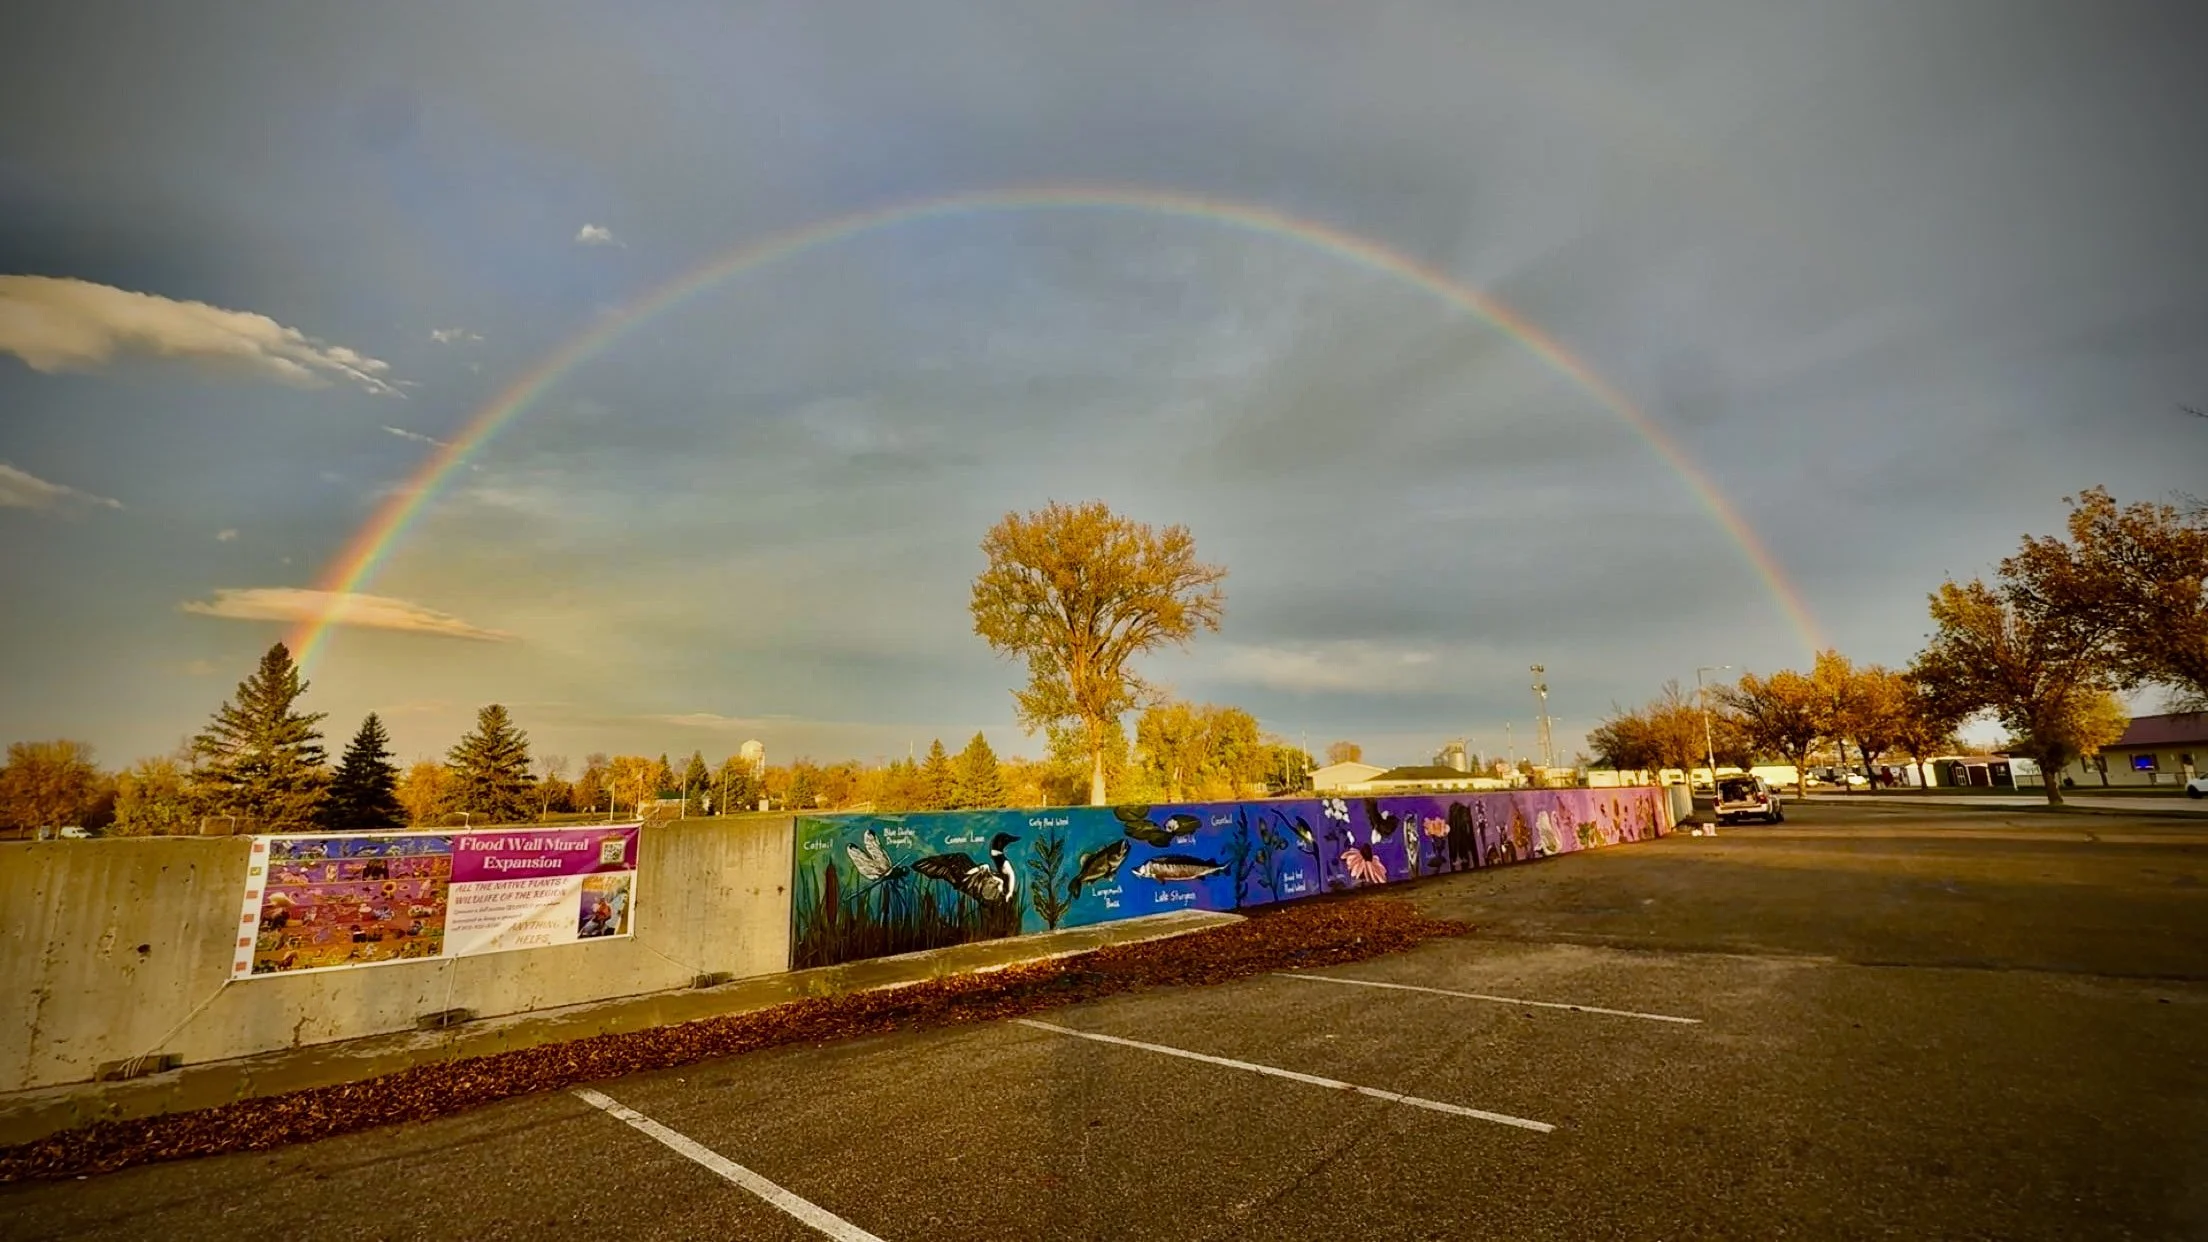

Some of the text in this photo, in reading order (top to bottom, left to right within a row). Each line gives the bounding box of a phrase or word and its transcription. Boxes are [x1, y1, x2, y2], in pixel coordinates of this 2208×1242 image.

[459, 837, 590, 851] Flood Wall Mural
[483, 855, 562, 872] Expansion
[474, 882, 494, 891] THE
[494, 880, 526, 890] NATIVE
[514, 891, 531, 900] THE
